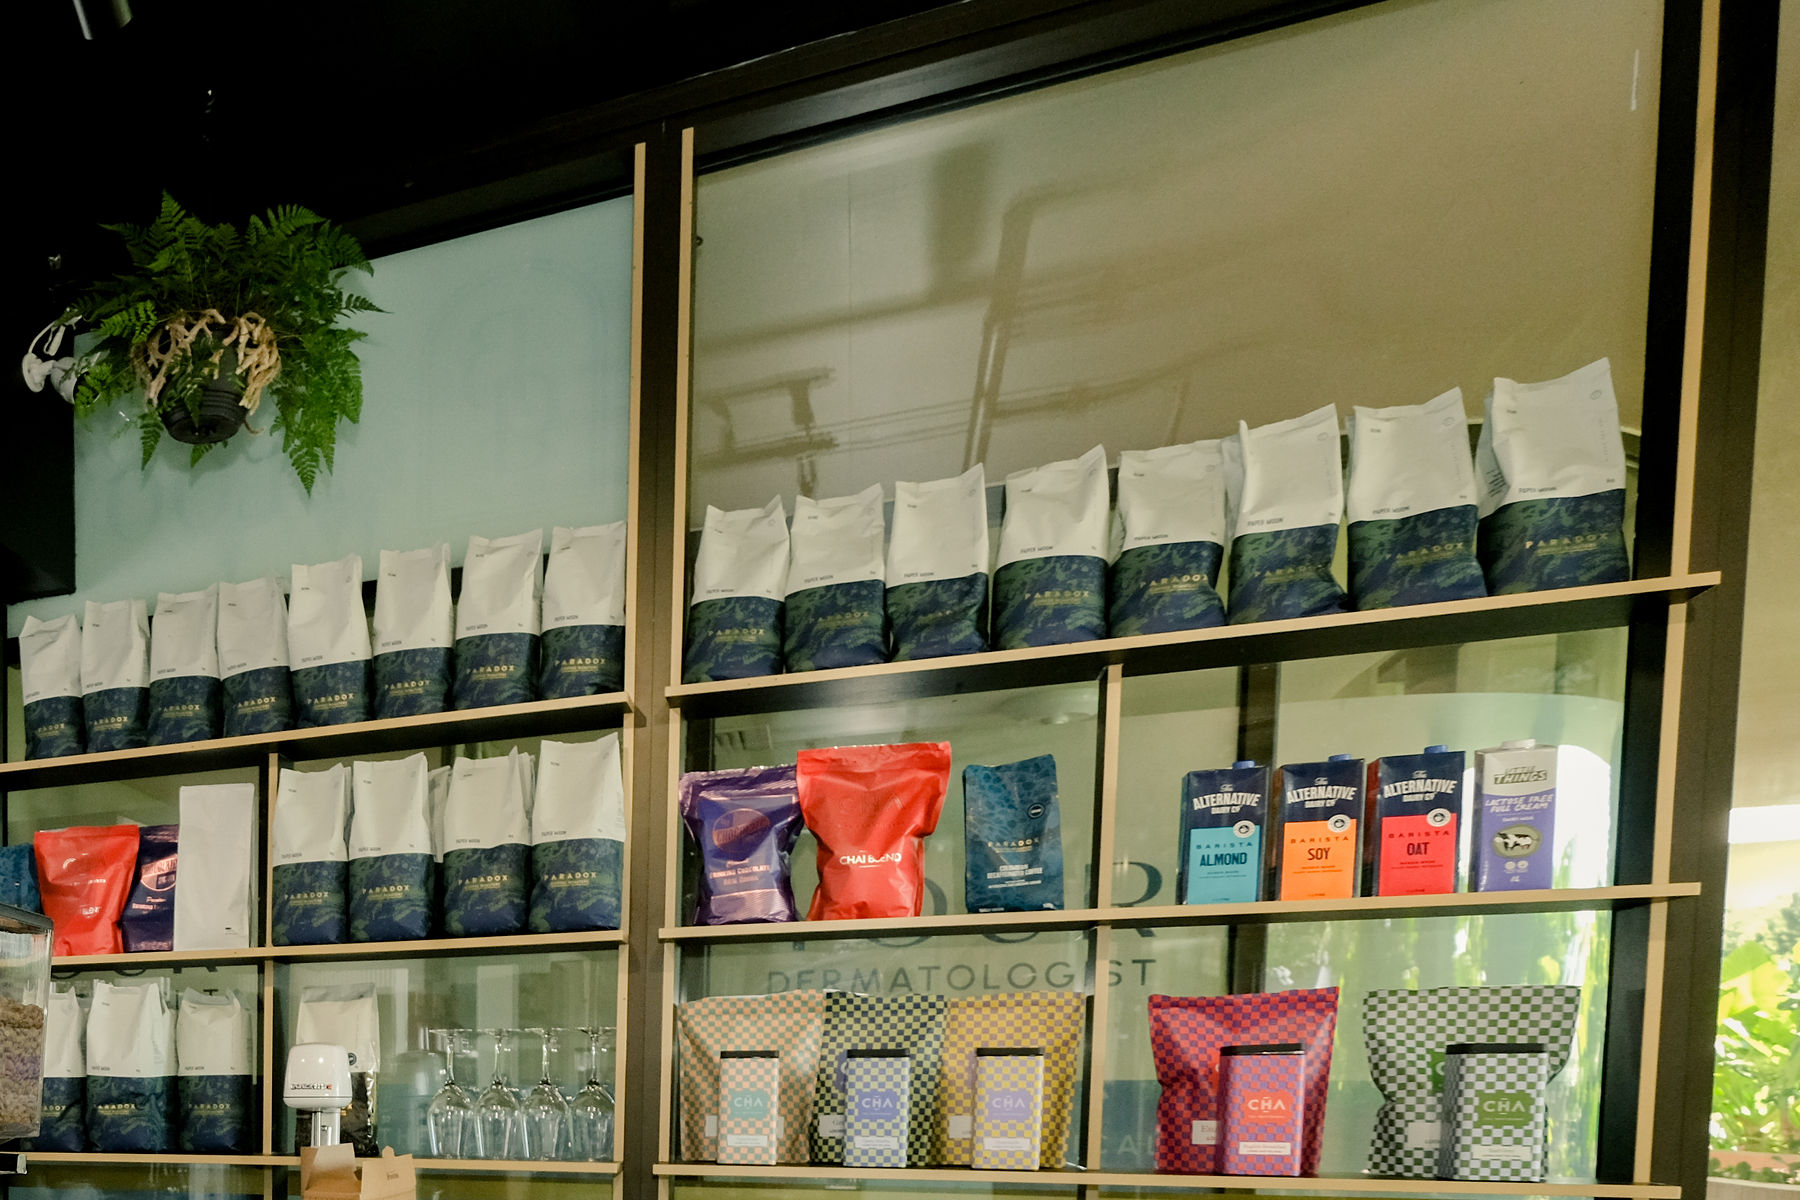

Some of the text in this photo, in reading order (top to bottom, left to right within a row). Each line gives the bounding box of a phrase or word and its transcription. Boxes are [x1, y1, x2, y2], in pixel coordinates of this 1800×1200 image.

[1493, 770, 1548, 784] THINGS
[1287, 785, 1358, 804] ALTERNATIVE
[1383, 778, 1458, 799] ALTERNATIVE
[1192, 792, 1262, 811] ALTERNATIVE
[1290, 835, 1349, 844] BARISTA
[1388, 829, 1450, 838] BARISTA
[1196, 841, 1253, 850] BARISTA
[1406, 842, 1430, 856] OAT
[839, 853, 867, 865] CHAI
[1200, 851, 1248, 867] ALMOND
[1307, 847, 1332, 861] SOY
[458, 875, 508, 885] PARADOX
[544, 871, 597, 881] PARADOX
[362, 884, 409, 894] PARADOX
[767, 958, 1158, 998] DERMATOLOGST
